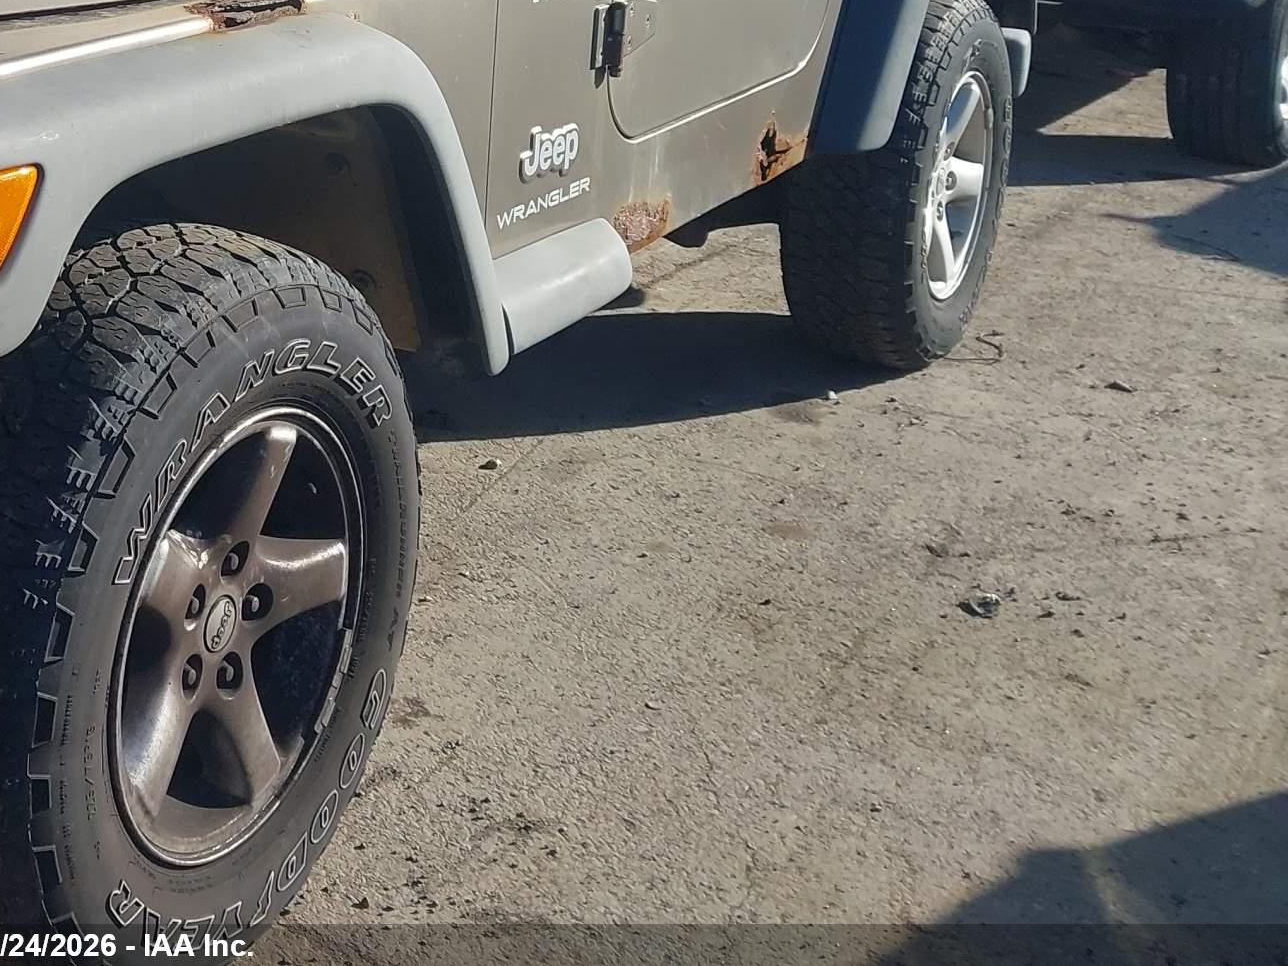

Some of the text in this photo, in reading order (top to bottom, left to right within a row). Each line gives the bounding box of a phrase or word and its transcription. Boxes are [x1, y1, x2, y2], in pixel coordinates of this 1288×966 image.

[496, 177, 590, 230] WRANGLER
[520, 123, 579, 182] Jeep
[114, 338, 393, 584] WRANGLER
[107, 668, 387, 951] GOODYEAR
